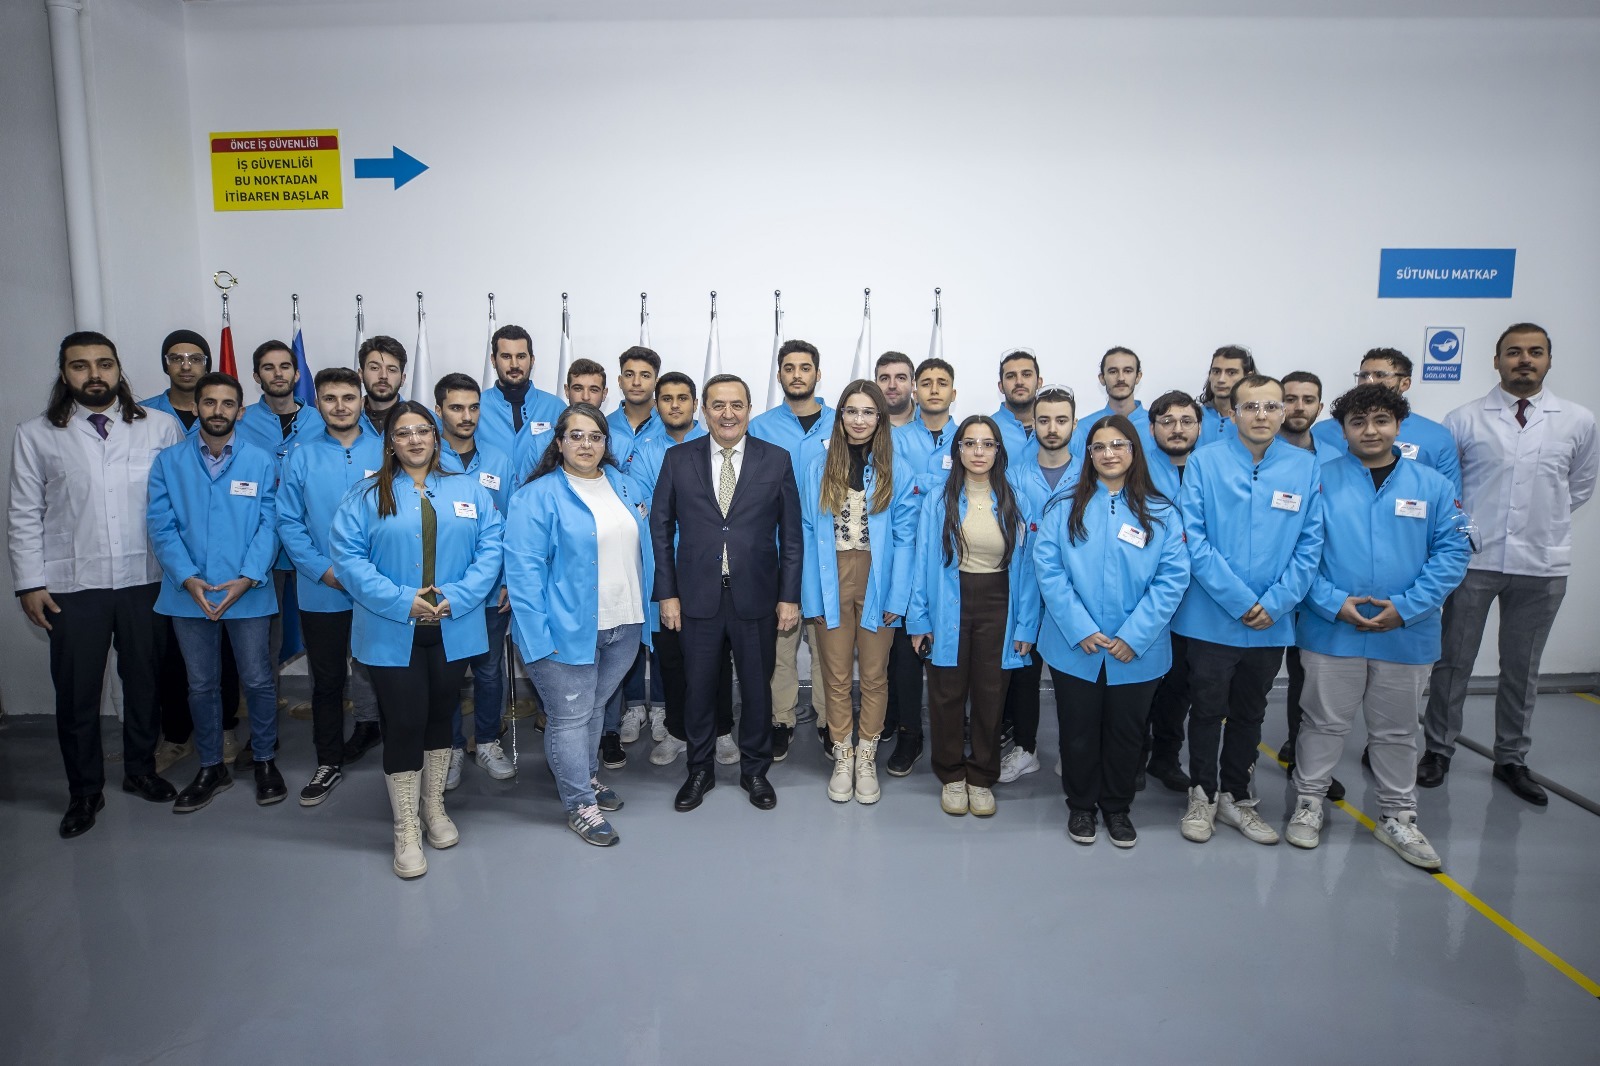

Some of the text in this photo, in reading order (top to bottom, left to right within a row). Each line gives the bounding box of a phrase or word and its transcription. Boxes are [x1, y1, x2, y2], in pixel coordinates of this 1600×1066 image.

[231, 137, 319, 151] ÖNCE İŞ GÜVENLİĞİ
[238, 156, 313, 172] İŞ GÜVENLİĞİ
[235, 175, 317, 186] BU NOKTADAN
[225, 190, 329, 203] İTİBAREN BAŞLAR
[1397, 267, 1497, 279] SÜTUNLU MATKAP
